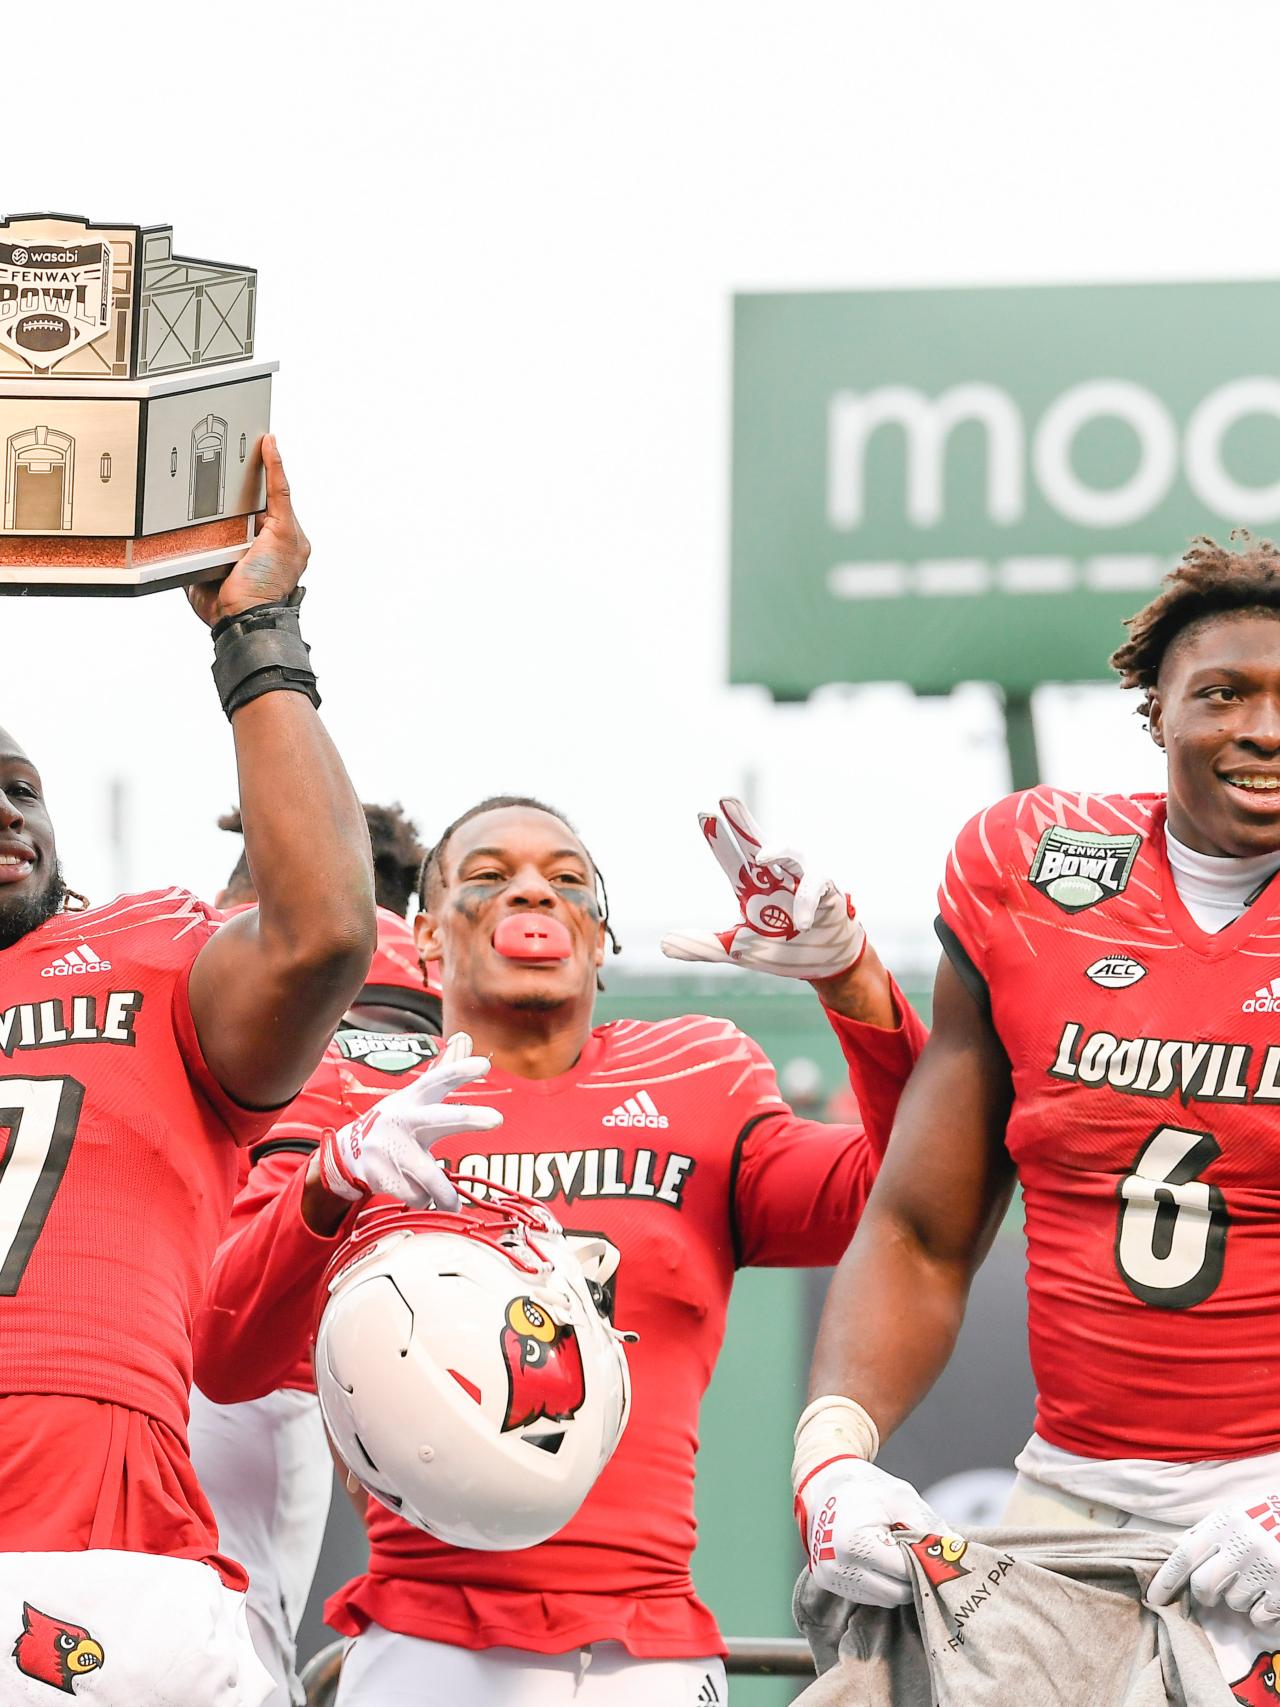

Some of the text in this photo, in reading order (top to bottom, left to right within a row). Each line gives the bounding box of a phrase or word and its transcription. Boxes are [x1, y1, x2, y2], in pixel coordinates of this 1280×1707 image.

[30, 249, 79, 263] wasabi
[11, 271, 81, 283] FENWAY
[1060, 844, 1116, 858] FENWAY
[1035, 850, 1119, 891] BOWL
[40, 959, 112, 978] adidas
[1093, 963, 1138, 976] ACC
[602, 1111, 669, 1130] adidas
[428, 1147, 696, 1209] OUISVILLE
[1114, 1124, 1229, 1310] 6
